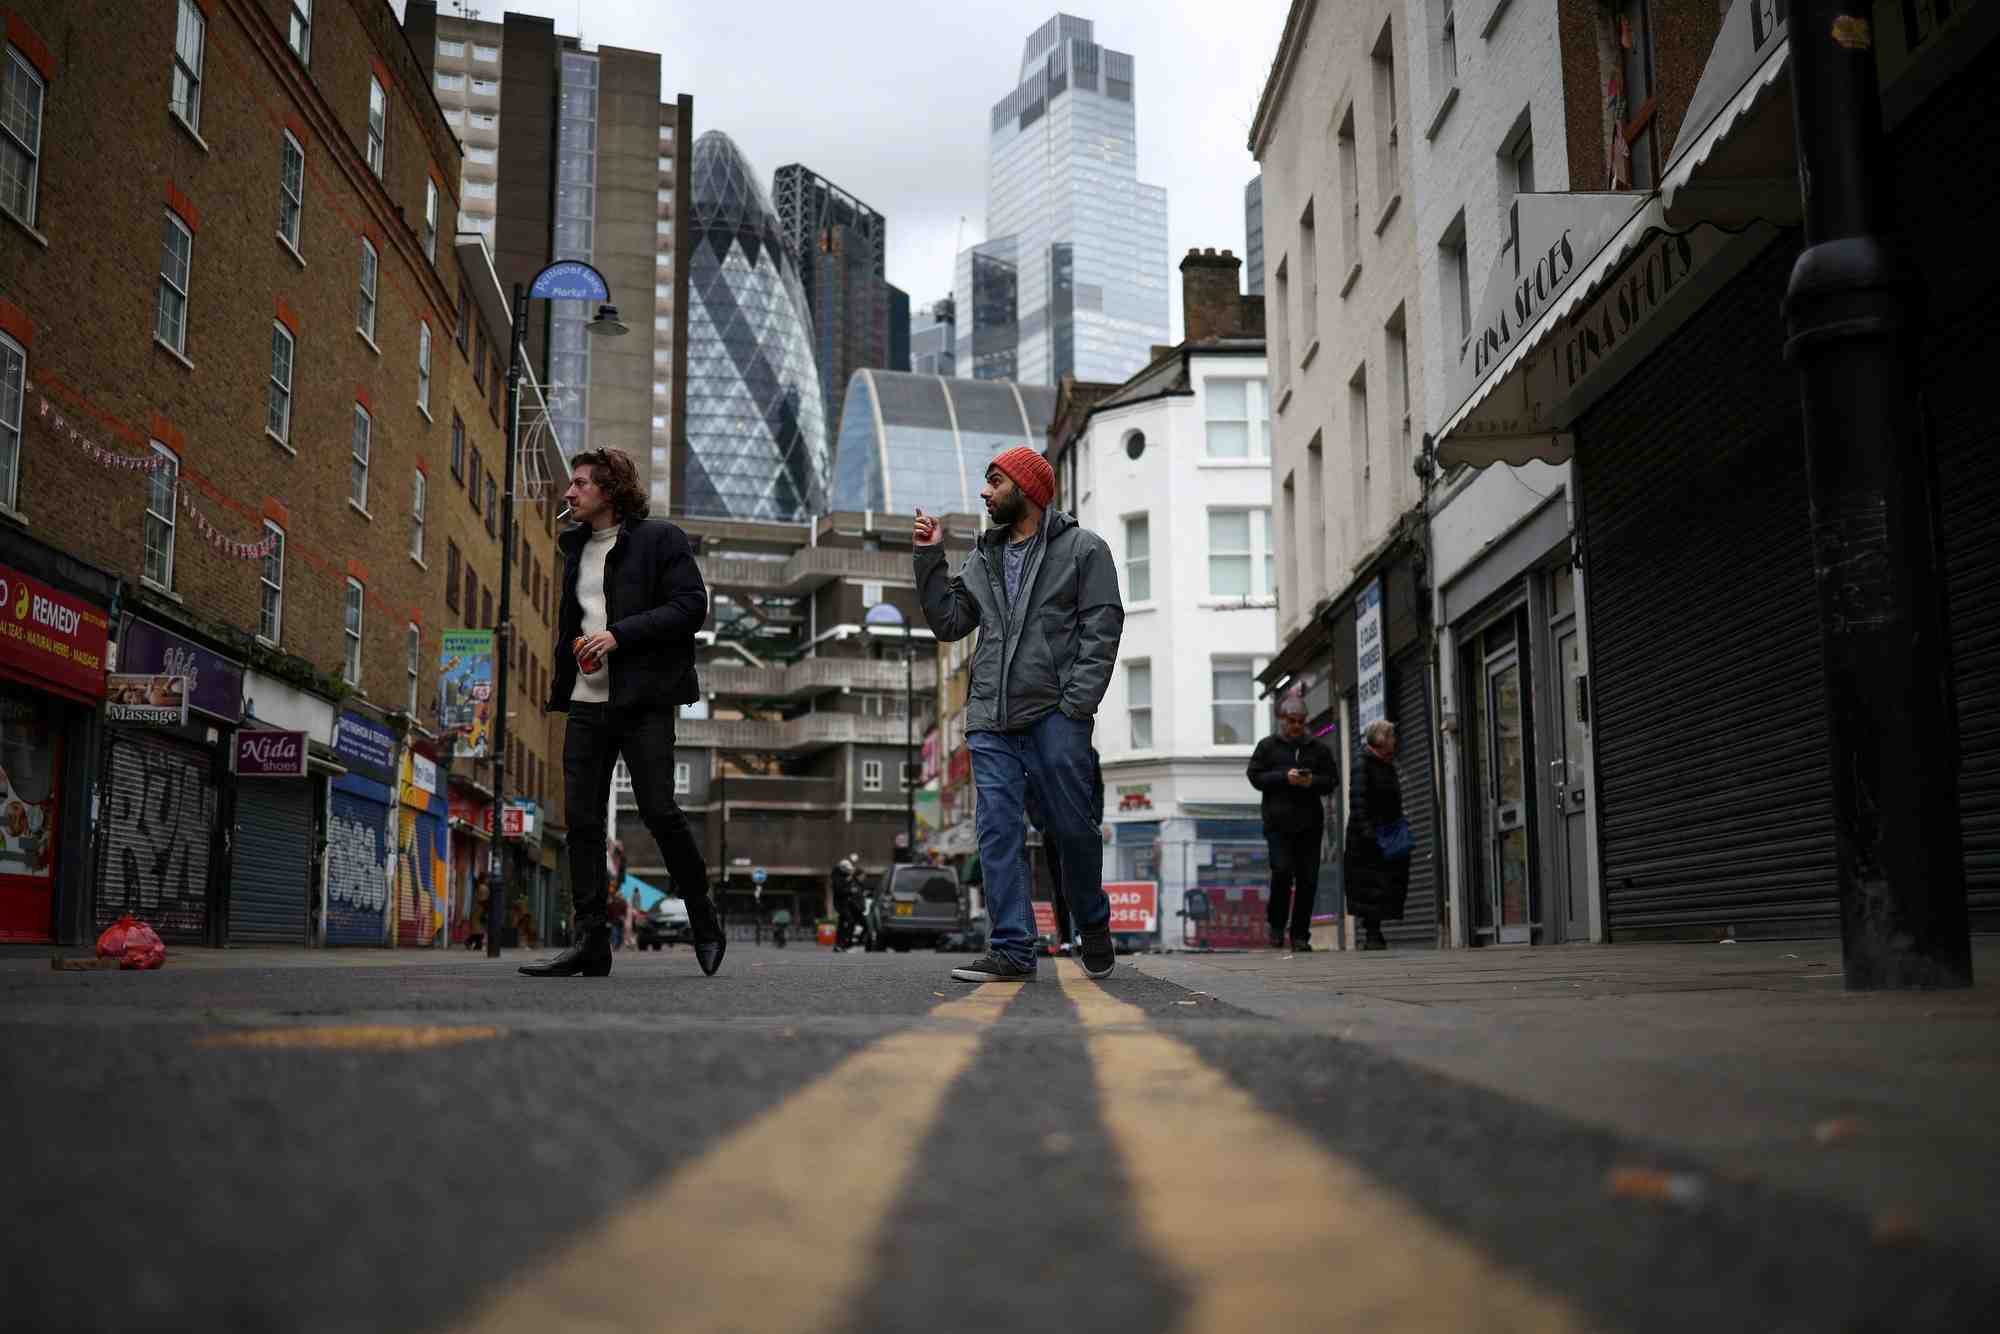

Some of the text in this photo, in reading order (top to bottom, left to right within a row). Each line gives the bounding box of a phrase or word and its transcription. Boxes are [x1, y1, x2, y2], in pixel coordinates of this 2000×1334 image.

[1514, 228, 1573, 328] SHOES
[1618, 234, 1692, 335] SHOES
[32, 594, 81, 637] REMEDY
[111, 706, 178, 725] Massage
[240, 736, 297, 763] Nida
[261, 758, 297, 772] shoes
[1110, 892, 1141, 904] OAD
[1110, 909, 1150, 922] OSED
